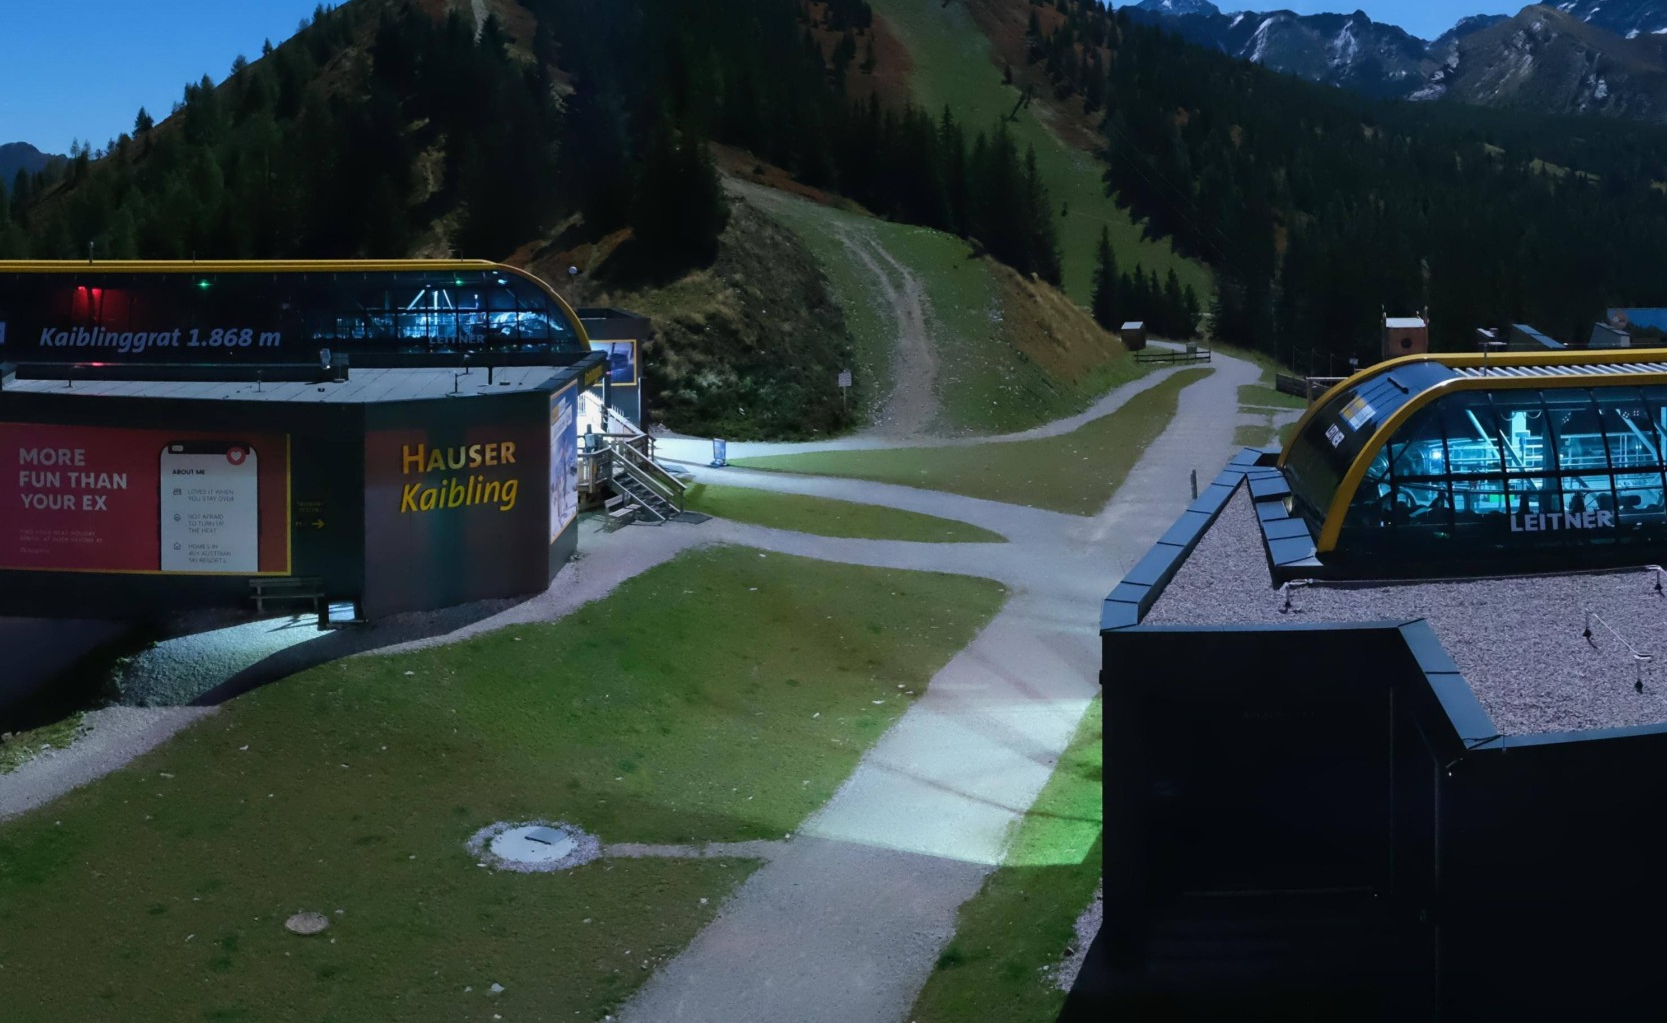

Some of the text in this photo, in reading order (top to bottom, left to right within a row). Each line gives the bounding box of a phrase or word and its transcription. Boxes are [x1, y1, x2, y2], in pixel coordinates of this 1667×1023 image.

[39, 326, 281, 353] Kaiblinggrat 1.868 m
[428, 334, 486, 345] LEITNER
[19, 447, 86, 466] MORE
[402, 441, 517, 474] HAUSER
[19, 470, 127, 489] FUN THAN
[20, 493, 108, 511] YOUR EX
[400, 475, 518, 513] Kaibling
[1510, 510, 1613, 532] LEITNER
